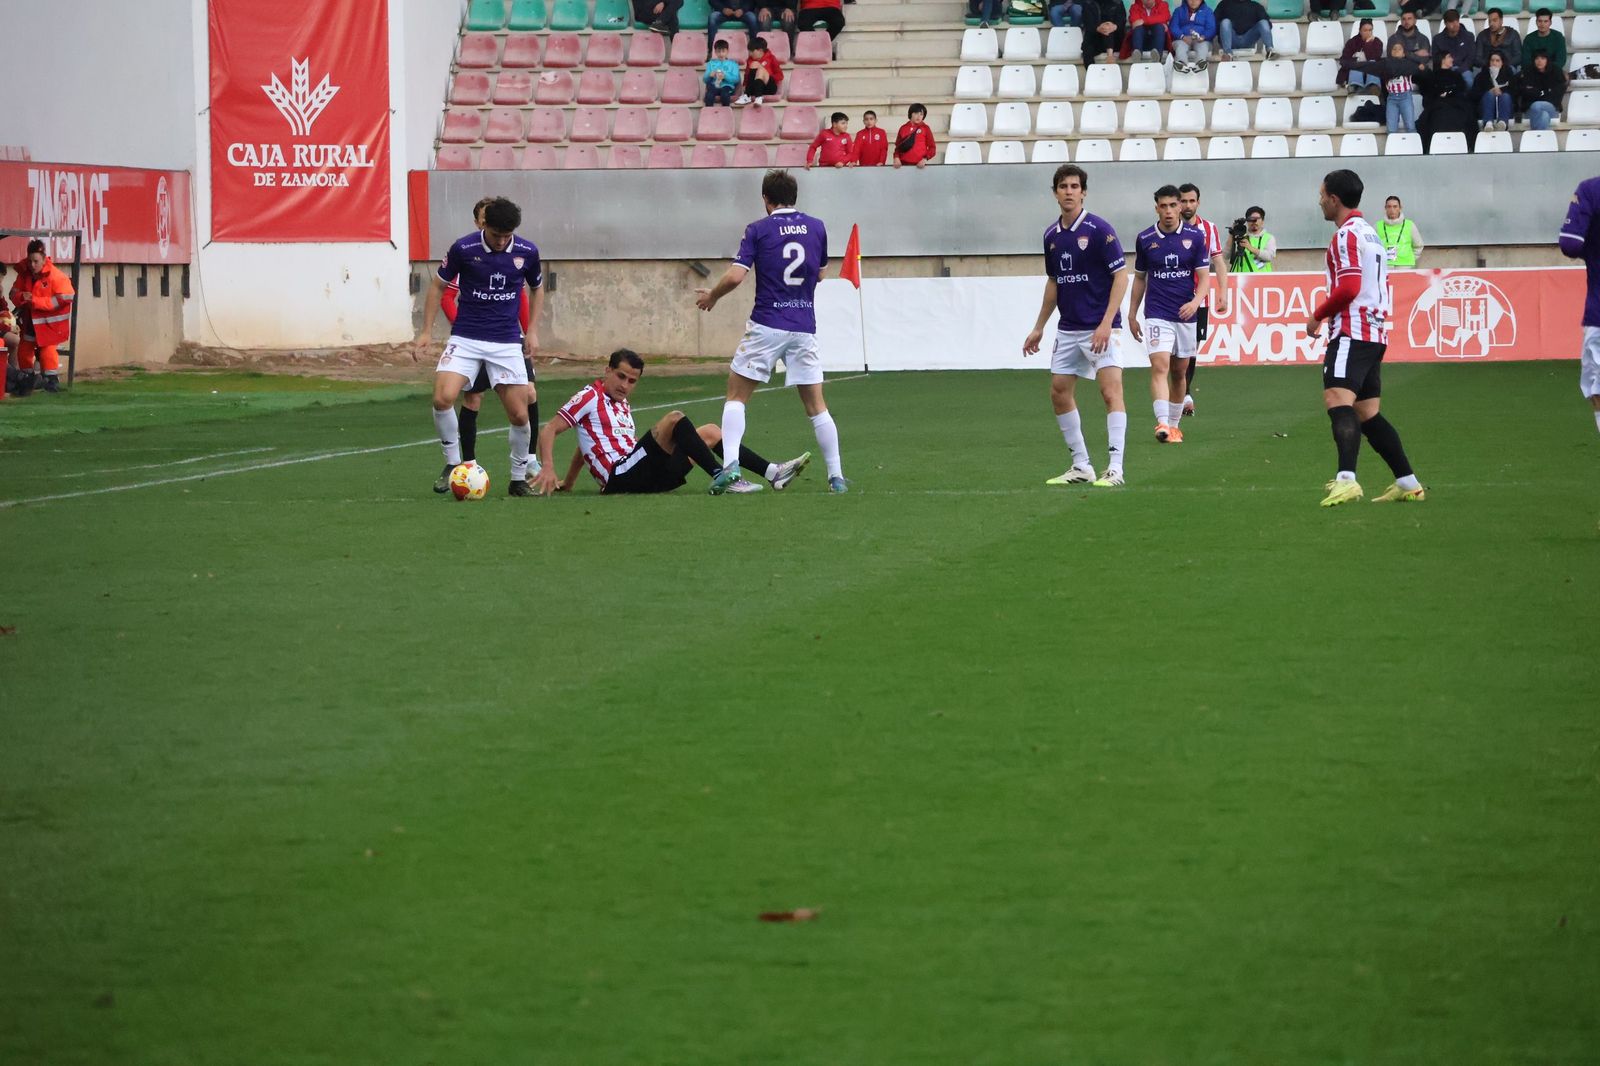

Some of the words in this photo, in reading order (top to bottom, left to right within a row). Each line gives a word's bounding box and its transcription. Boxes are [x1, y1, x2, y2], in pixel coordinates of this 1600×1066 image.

[227, 142, 288, 168] CAJA
[292, 143, 375, 168] RURAL
[253, 172, 277, 187] DE
[281, 172, 350, 188] ZAMORA
[90, 173, 109, 258] CF
[779, 224, 808, 236] LUCAS
[782, 241, 806, 286] 2
[1056, 273, 1089, 284] ercesa
[1153, 269, 1192, 280] Hercesa
[472, 288, 517, 301] Hercesa
[1149, 325, 1161, 339] 19
